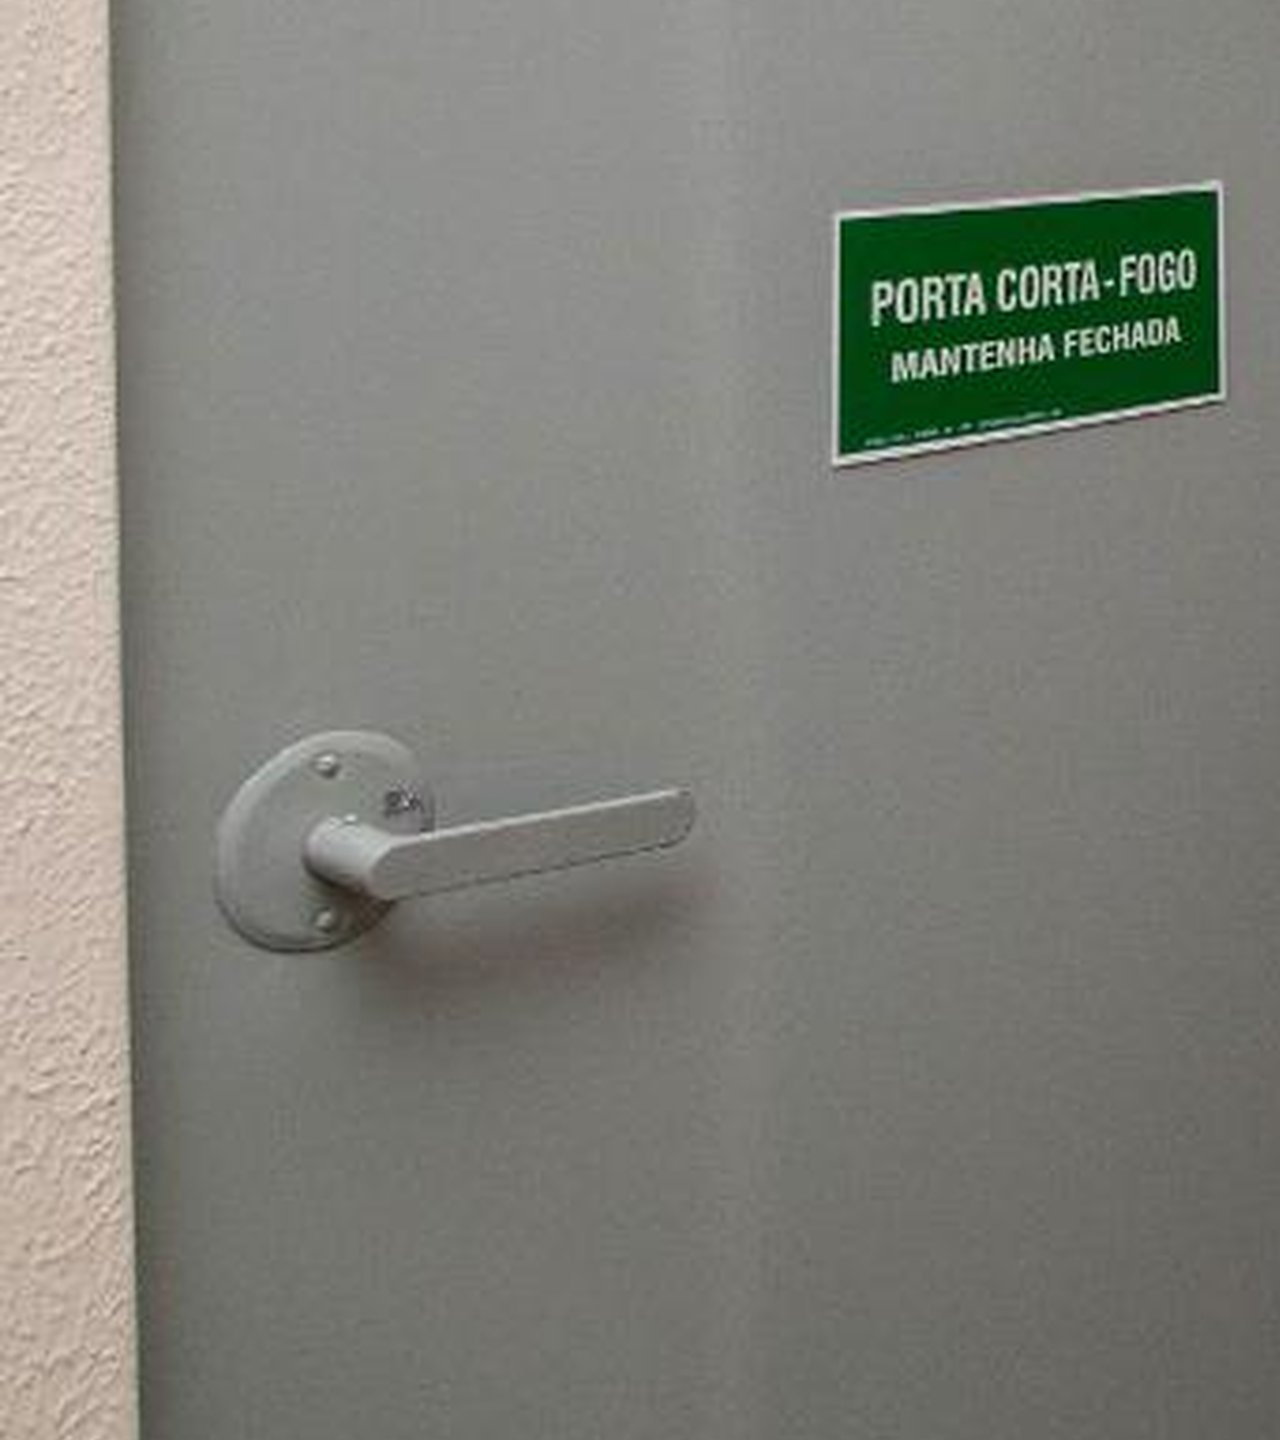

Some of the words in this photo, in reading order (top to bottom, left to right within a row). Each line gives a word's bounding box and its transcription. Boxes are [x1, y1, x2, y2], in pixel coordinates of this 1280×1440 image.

[870, 272, 987, 327] PORTA
[890, 333, 1055, 383] MANTENHA
[1064, 316, 1182, 359] FECHADA
